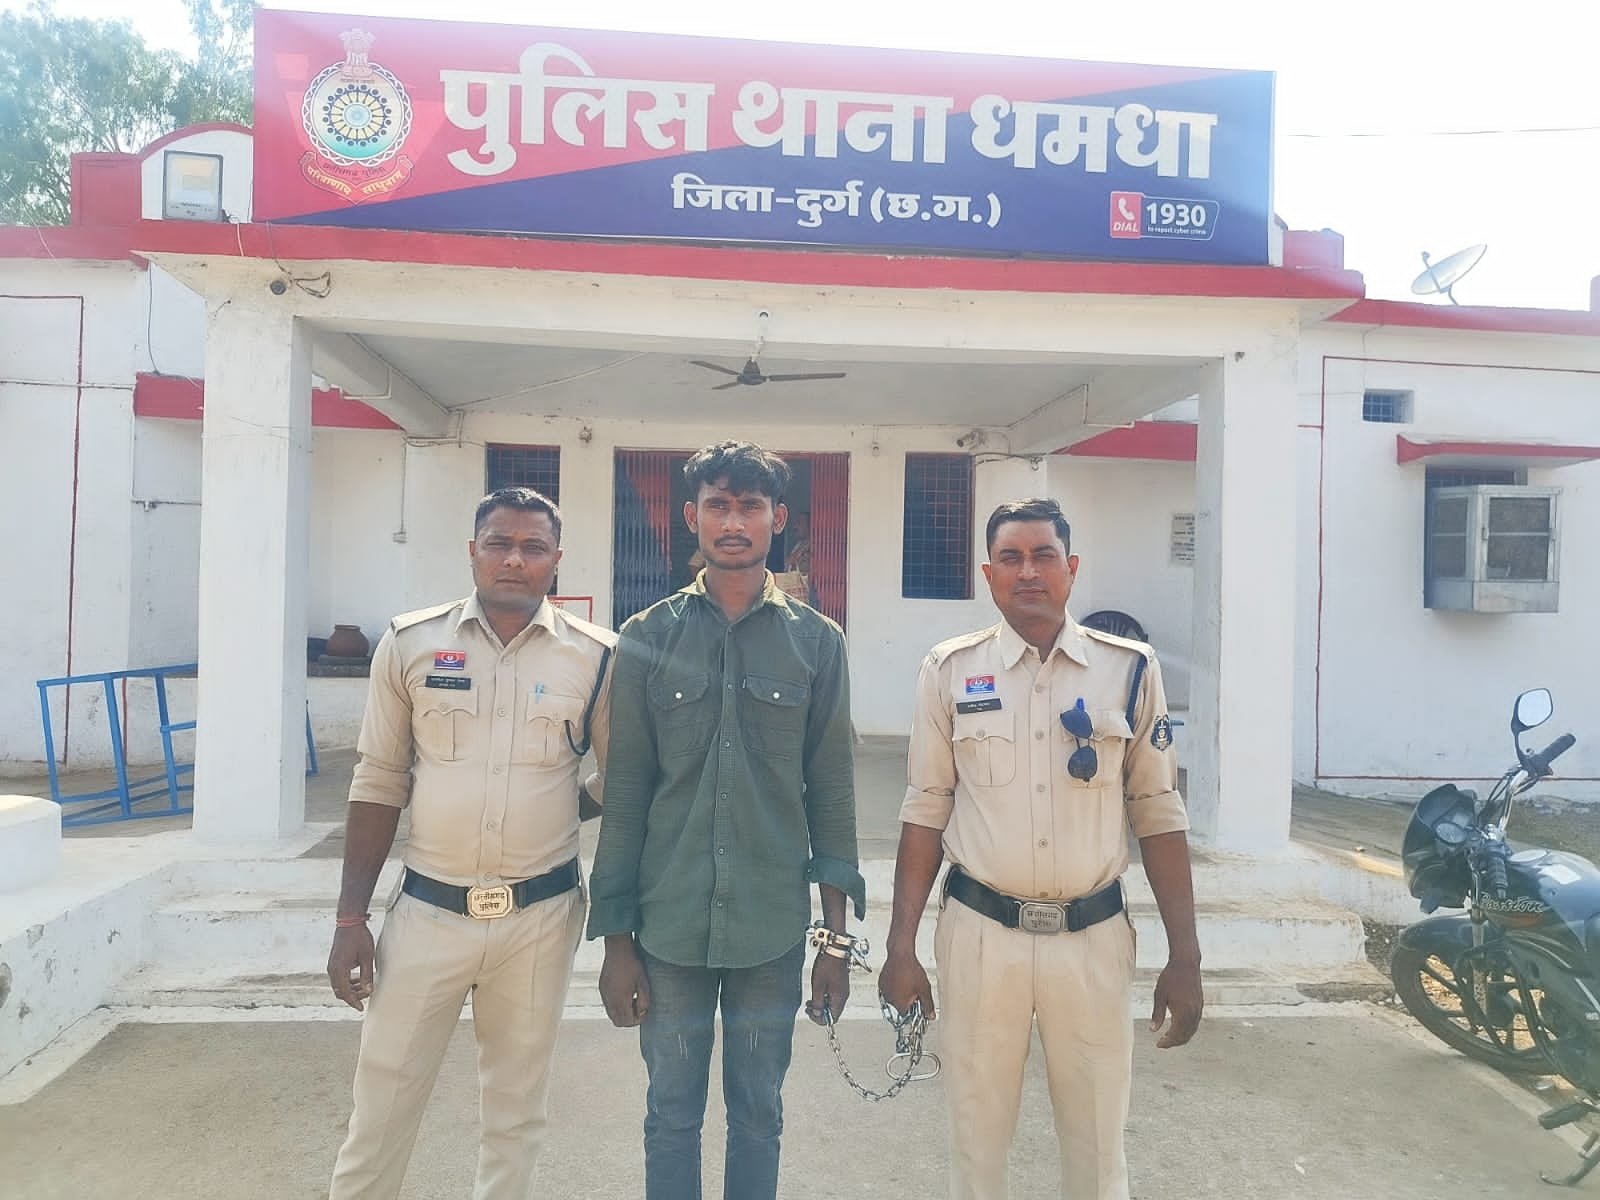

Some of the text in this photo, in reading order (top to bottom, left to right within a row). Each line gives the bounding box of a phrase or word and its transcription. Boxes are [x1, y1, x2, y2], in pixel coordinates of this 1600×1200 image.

[439, 42, 1218, 178] पुलिस थाना धमधा
[871, 187, 1001, 229] (छ.ग.)
[1146, 202, 1206, 227] 1930
[1113, 222, 1138, 233] DIAL
